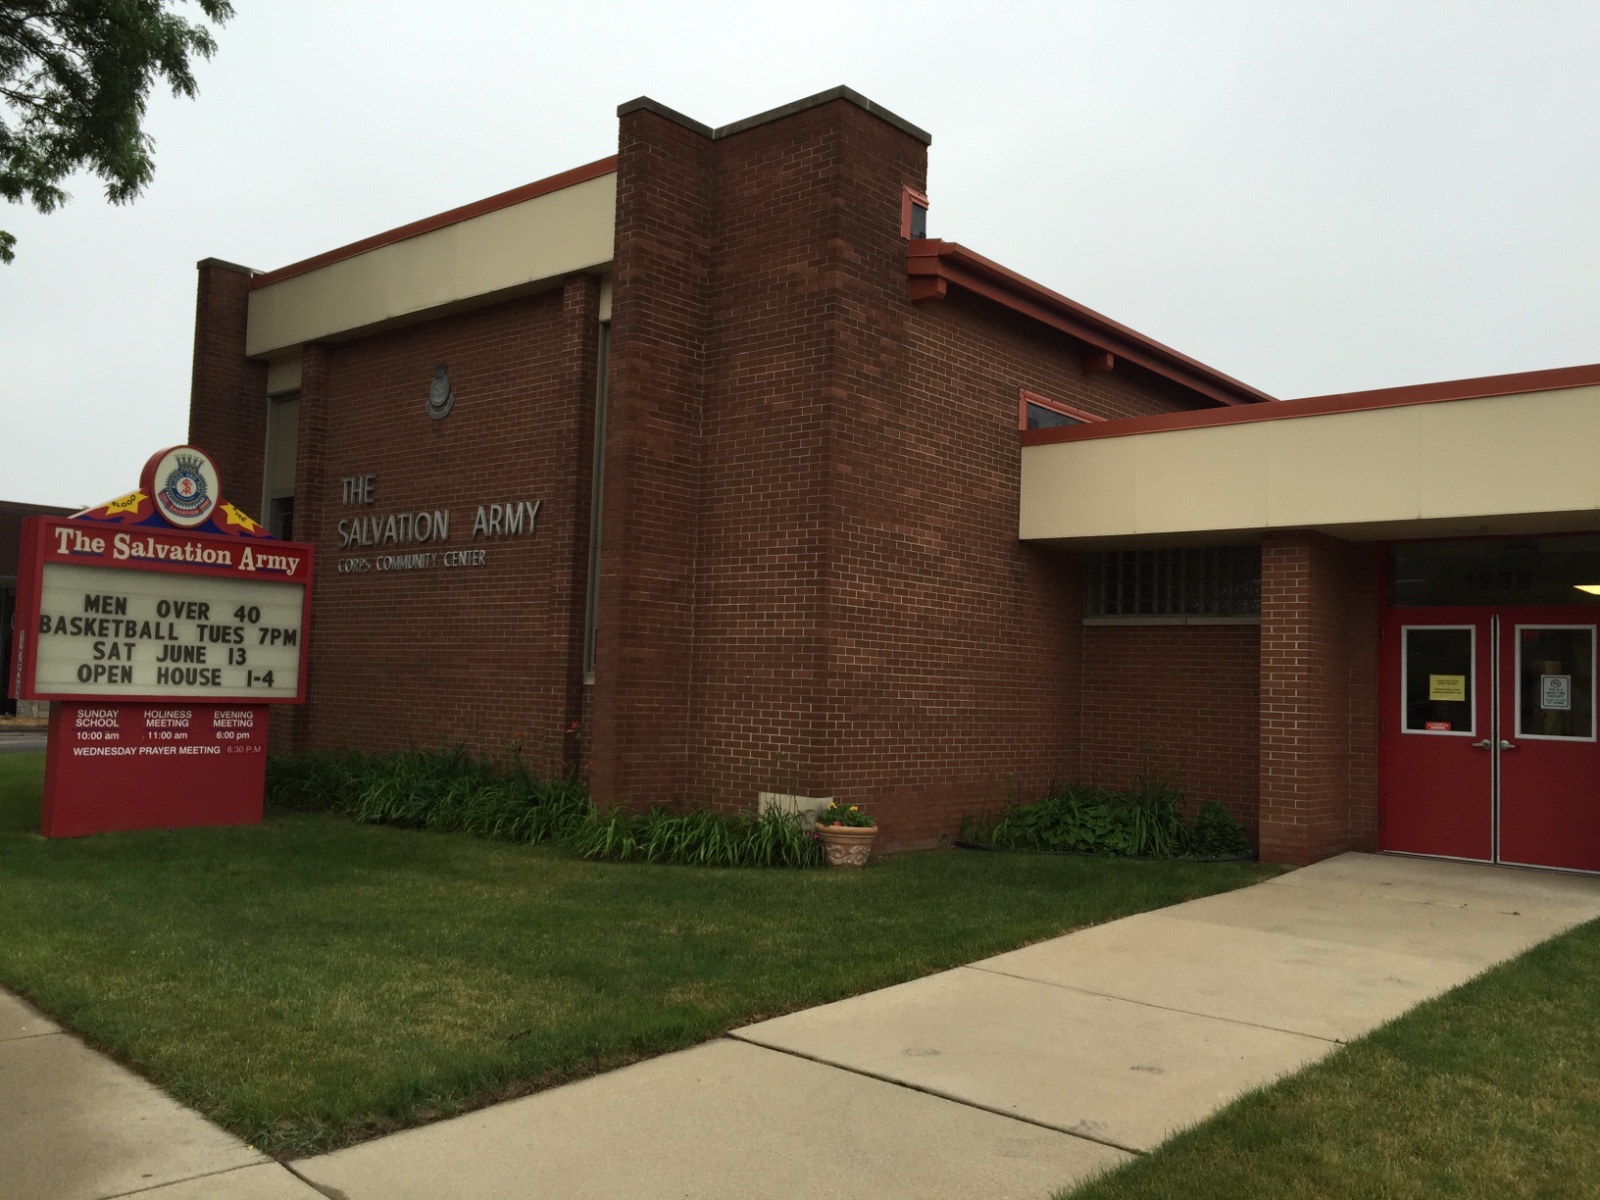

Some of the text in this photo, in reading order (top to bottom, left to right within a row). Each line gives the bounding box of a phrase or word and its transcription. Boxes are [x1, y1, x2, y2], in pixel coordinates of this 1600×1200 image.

[341, 474, 376, 506] THE
[111, 494, 137, 508] BLOOD
[337, 500, 541, 548] SALVATION ARMY
[55, 527, 300, 576] The Salvation Army
[337, 549, 487, 574] CORPS COMMUNITY CENTER
[84, 594, 261, 624] MEN OVER 40
[39, 615, 297, 647] BASKETBALL TUES 7PM
[93, 641, 247, 666] SAT JUNE 13
[77, 664, 275, 688] OPEN HOUSE 1-4
[77, 710, 119, 718] SUNDAY
[144, 710, 192, 719] HOLINESS
[214, 711, 253, 719] EVENING
[75, 718, 120, 728] SCHOOL
[146, 718, 189, 728] MEETING
[213, 719, 254, 728] MEETING
[76, 731, 103, 740] 10:00
[147, 731, 172, 740] 11:00
[216, 731, 250, 741] 6:00 pm
[73, 747, 137, 756] WEDNESDAY
[138, 746, 177, 755] PRAYER
[178, 746, 221, 755] MEETING
